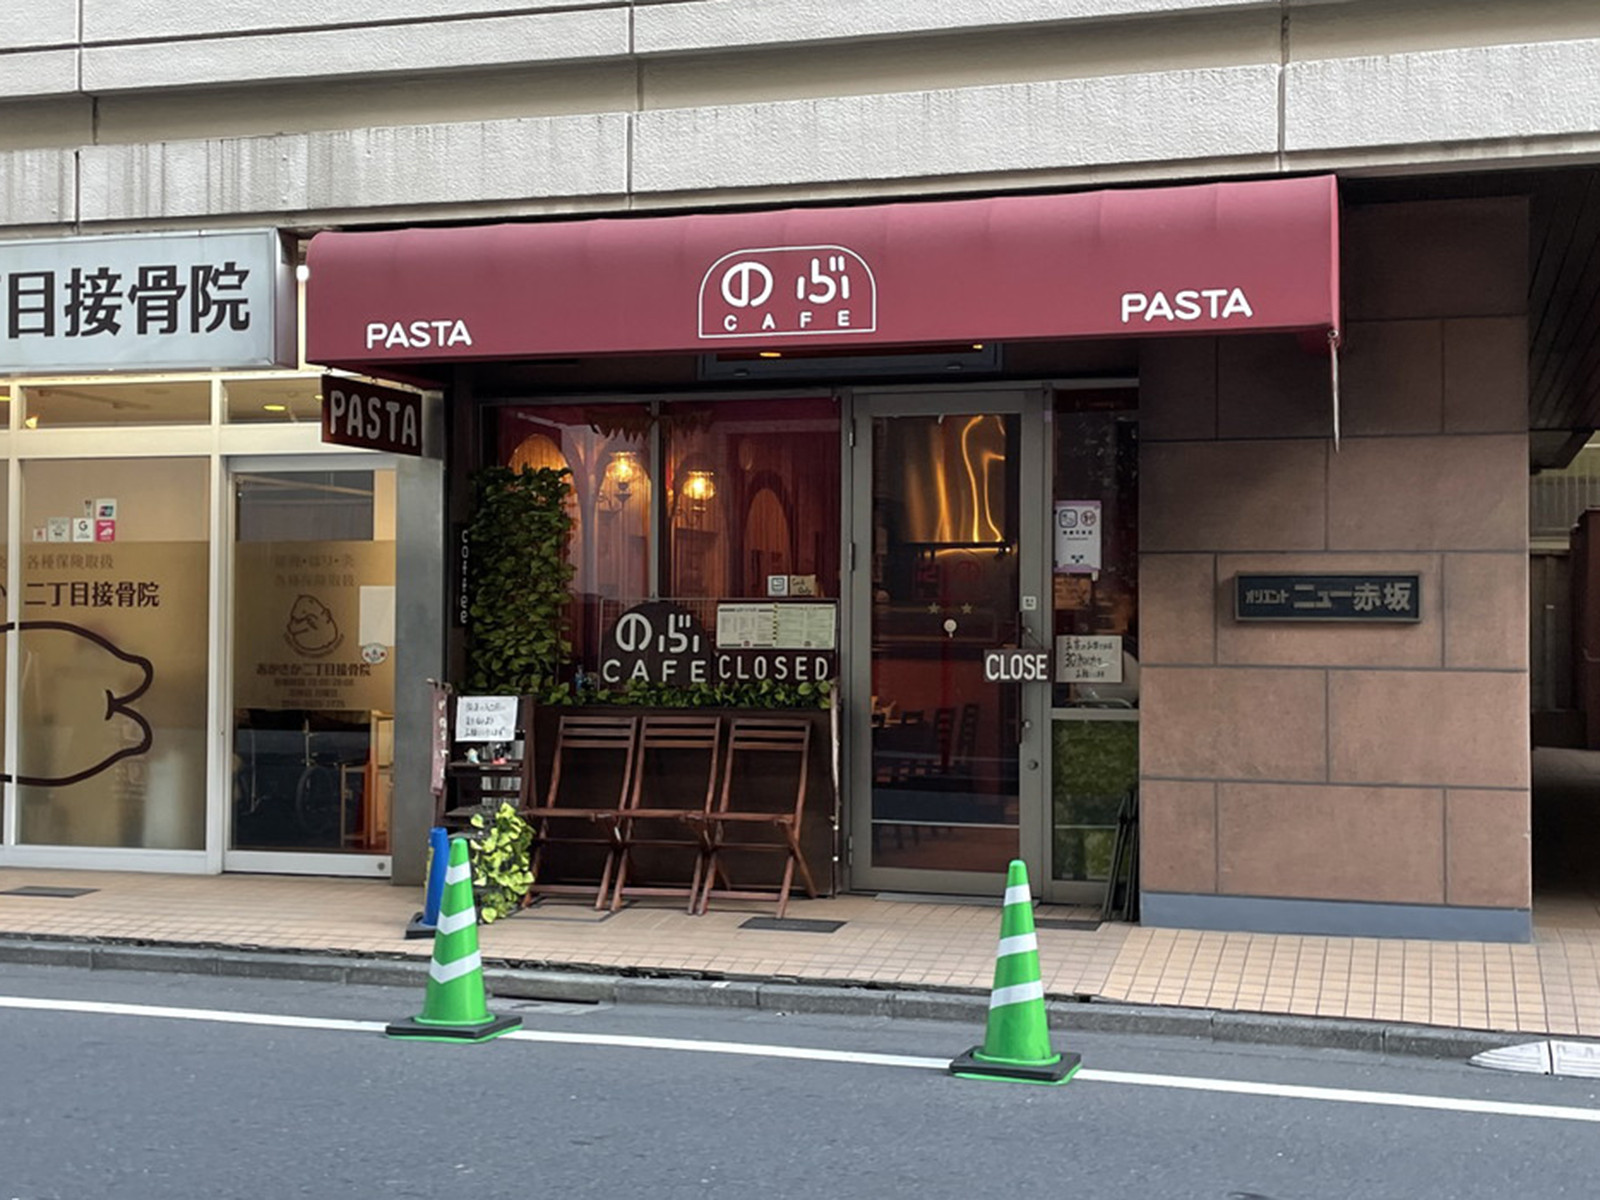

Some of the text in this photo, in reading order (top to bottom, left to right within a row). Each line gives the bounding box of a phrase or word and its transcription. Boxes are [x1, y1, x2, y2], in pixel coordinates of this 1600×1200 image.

[721, 255, 850, 308] のぶ
[0, 261, 250, 339] 目接骨院
[1121, 287, 1253, 323] PASTA
[366, 319, 472, 349] PASTA
[723, 310, 850, 332] CAFE
[330, 389, 417, 447] PASTA
[24, 581, 160, 608] 二丁目接骨院
[1293, 583, 1412, 611] ニュー赤坂
[615, 612, 700, 653] のぶ
[602, 659, 707, 683] CAFE
[718, 655, 829, 681] CLOSED
[985, 654, 1048, 681] CLOSE
